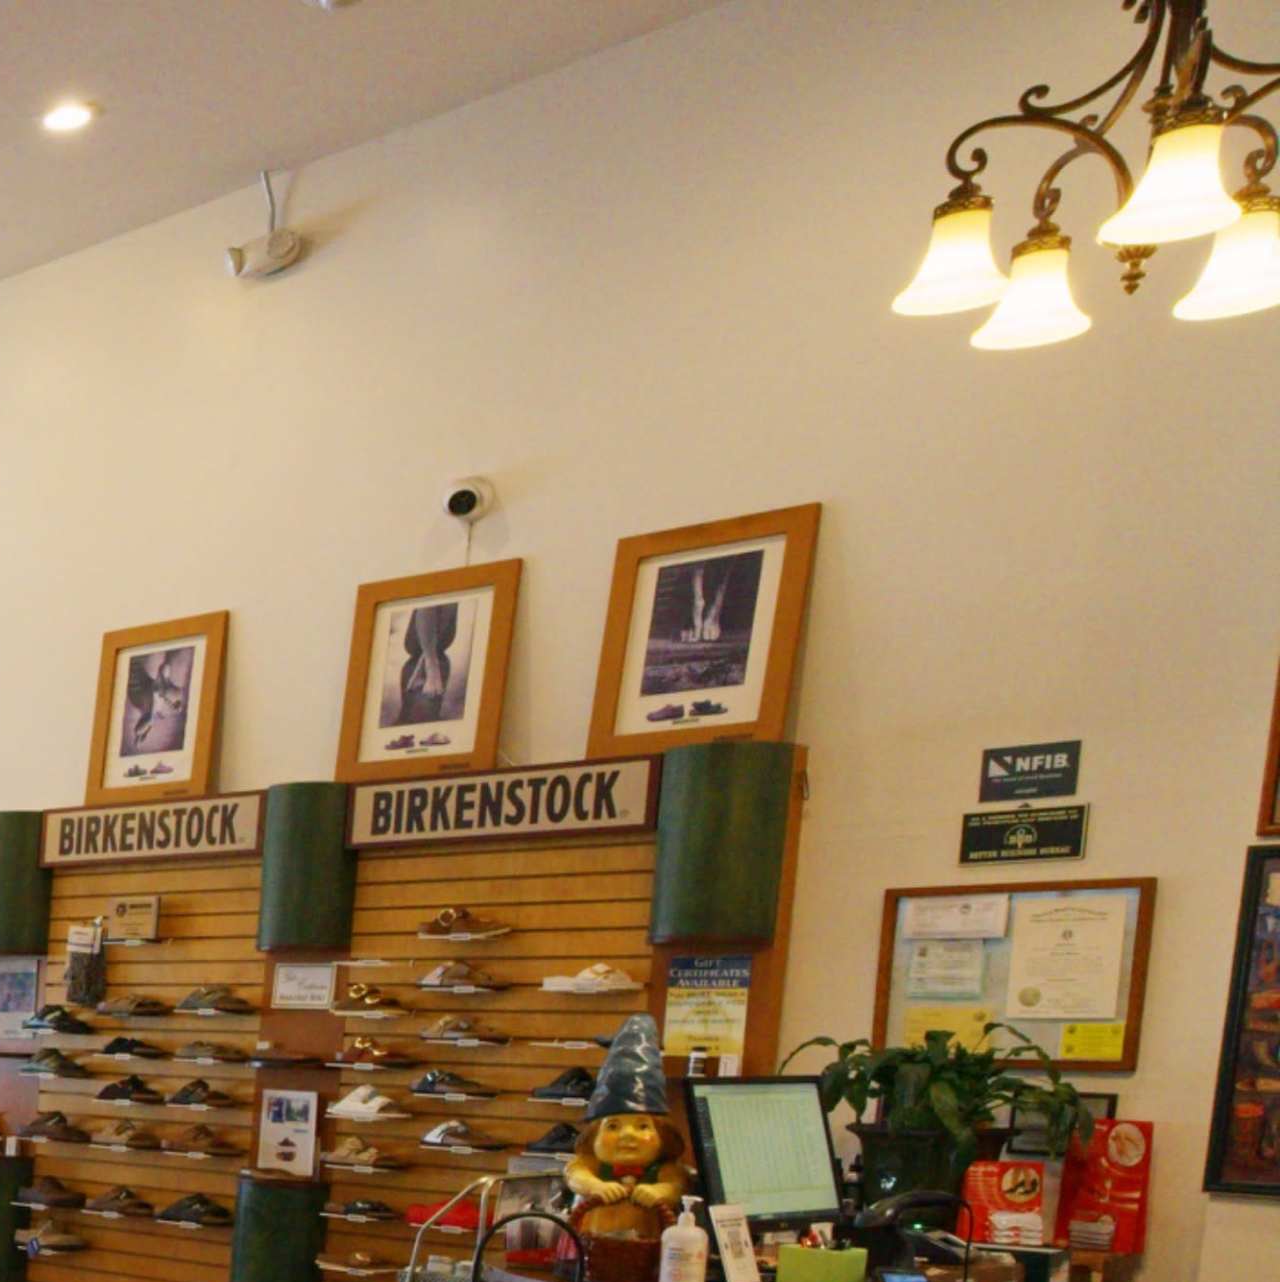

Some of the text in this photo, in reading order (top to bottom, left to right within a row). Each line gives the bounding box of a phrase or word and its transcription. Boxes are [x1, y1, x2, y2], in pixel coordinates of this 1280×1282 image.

[1015, 753, 1069, 772] NFIB
[58, 803, 239, 856] BIRKENSTOCK
[370, 770, 620, 836] BIRKENSTOCK
